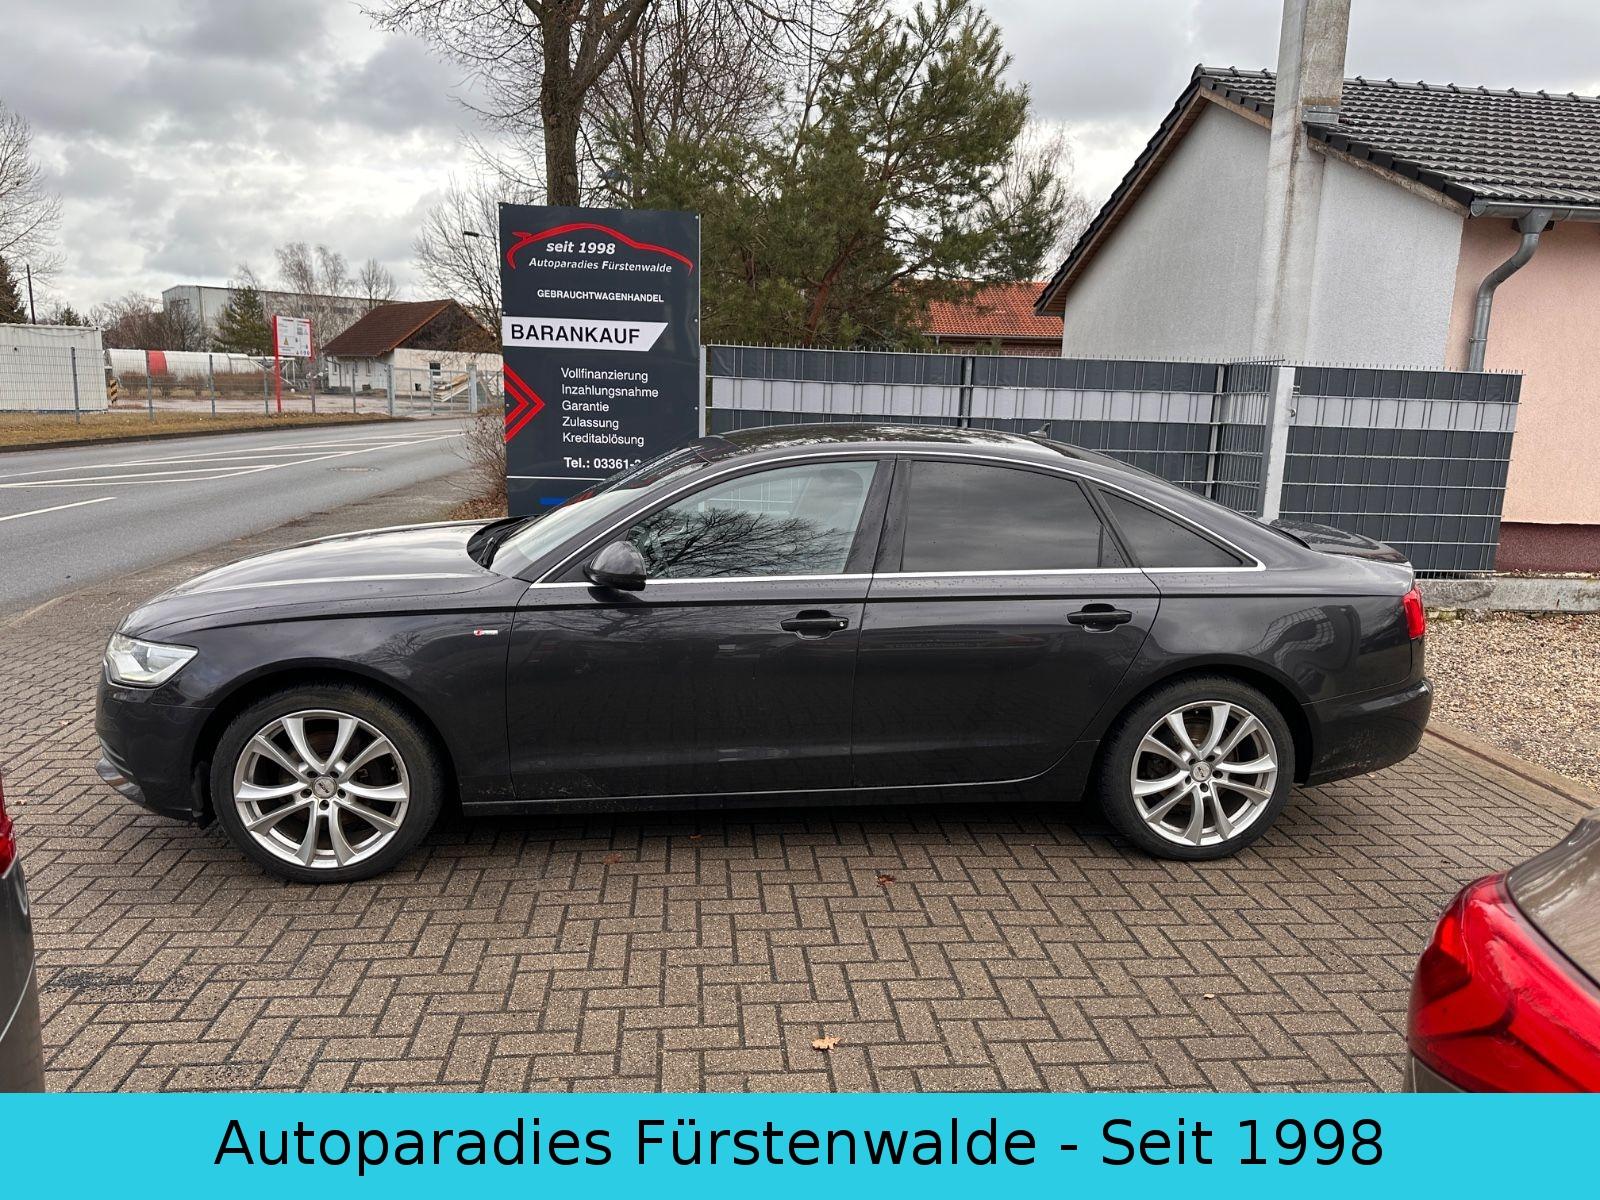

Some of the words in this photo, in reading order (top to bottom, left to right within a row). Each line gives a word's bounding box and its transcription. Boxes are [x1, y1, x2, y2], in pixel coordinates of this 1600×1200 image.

[546, 241, 575, 253] seit
[578, 242, 616, 255] 1998
[528, 258, 599, 270] Autoparadies
[601, 260, 673, 273] Fürstenwalde
[537, 289, 665, 303] GEBRAUCHTWAGENHANDEL
[511, 324, 640, 344] BARANKAUF
[561, 367, 649, 383] Vollfinanzierung
[561, 384, 659, 399] Inzahlungsnahme
[562, 400, 610, 412] Garantie
[562, 416, 619, 431] Zulassung
[562, 432, 645, 448] Kreditablösung
[563, 457, 590, 469] Tel.:
